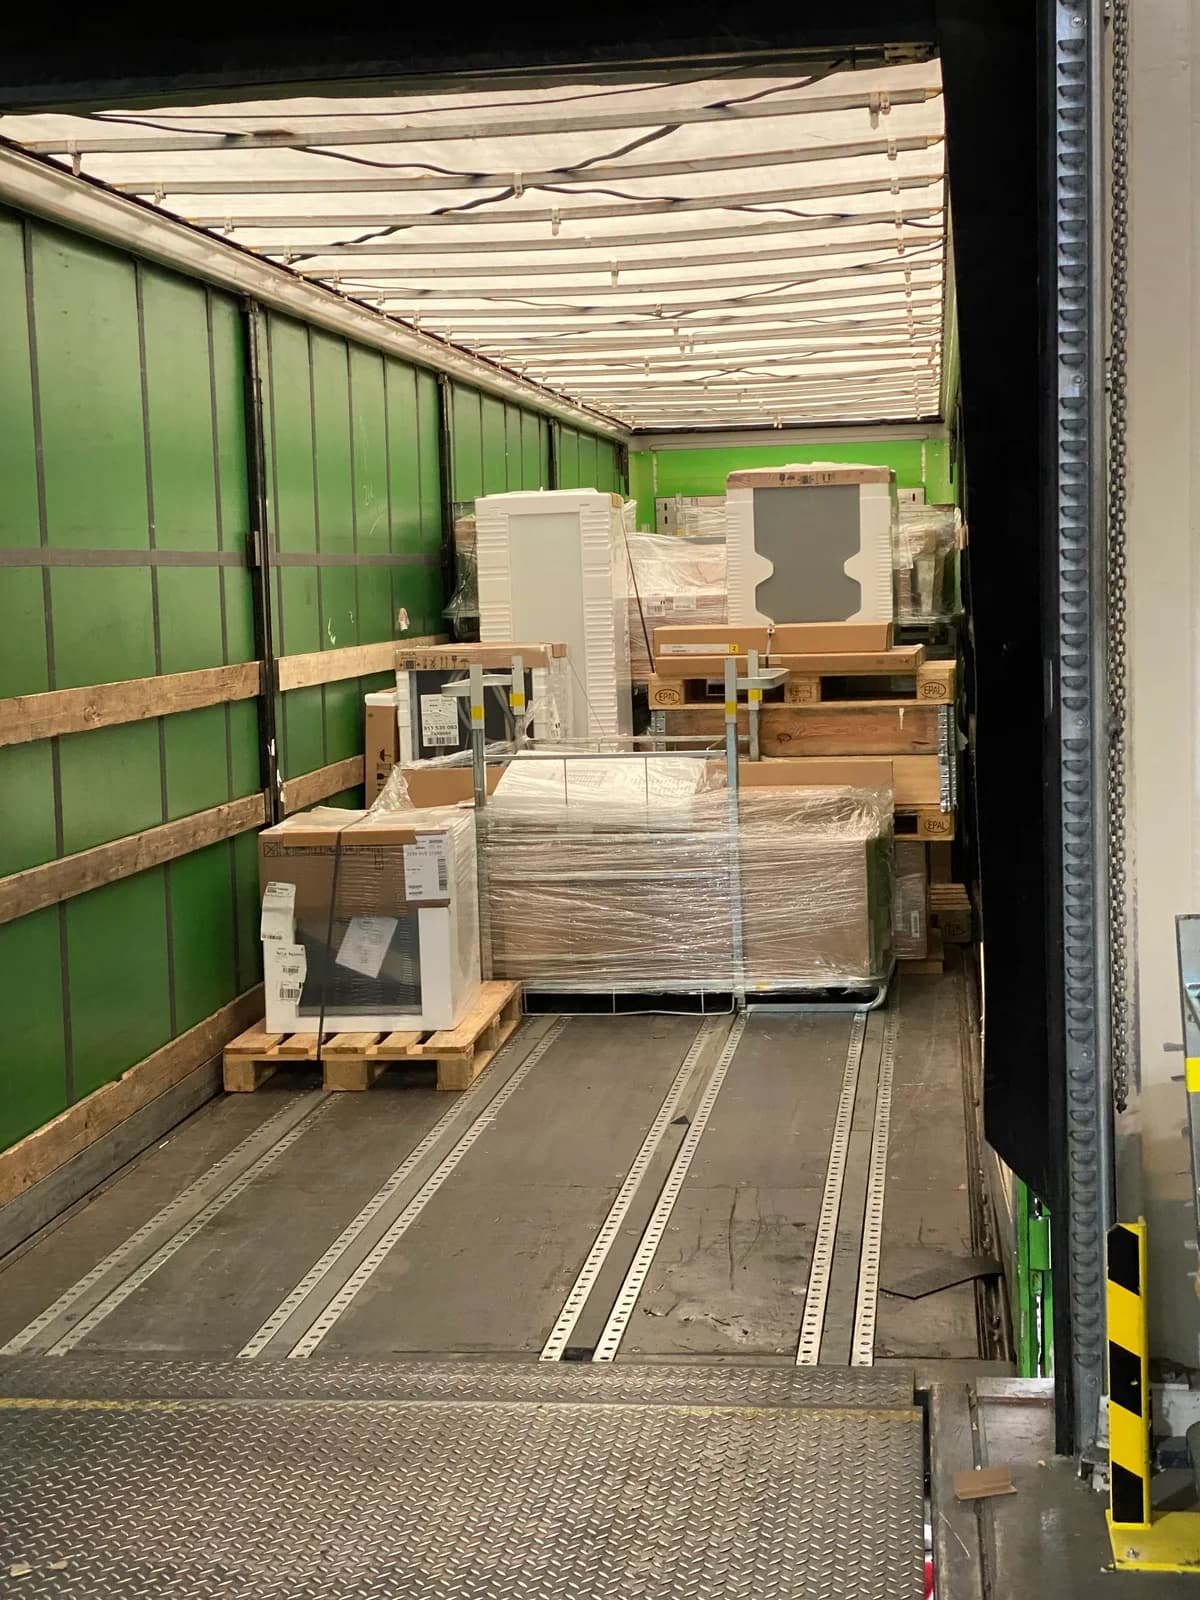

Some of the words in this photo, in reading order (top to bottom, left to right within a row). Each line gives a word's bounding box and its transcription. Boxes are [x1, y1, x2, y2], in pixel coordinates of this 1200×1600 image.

[924, 685, 943, 695] EPAL
[659, 691, 676, 702] EPAL
[927, 820, 946, 830] EPAL
